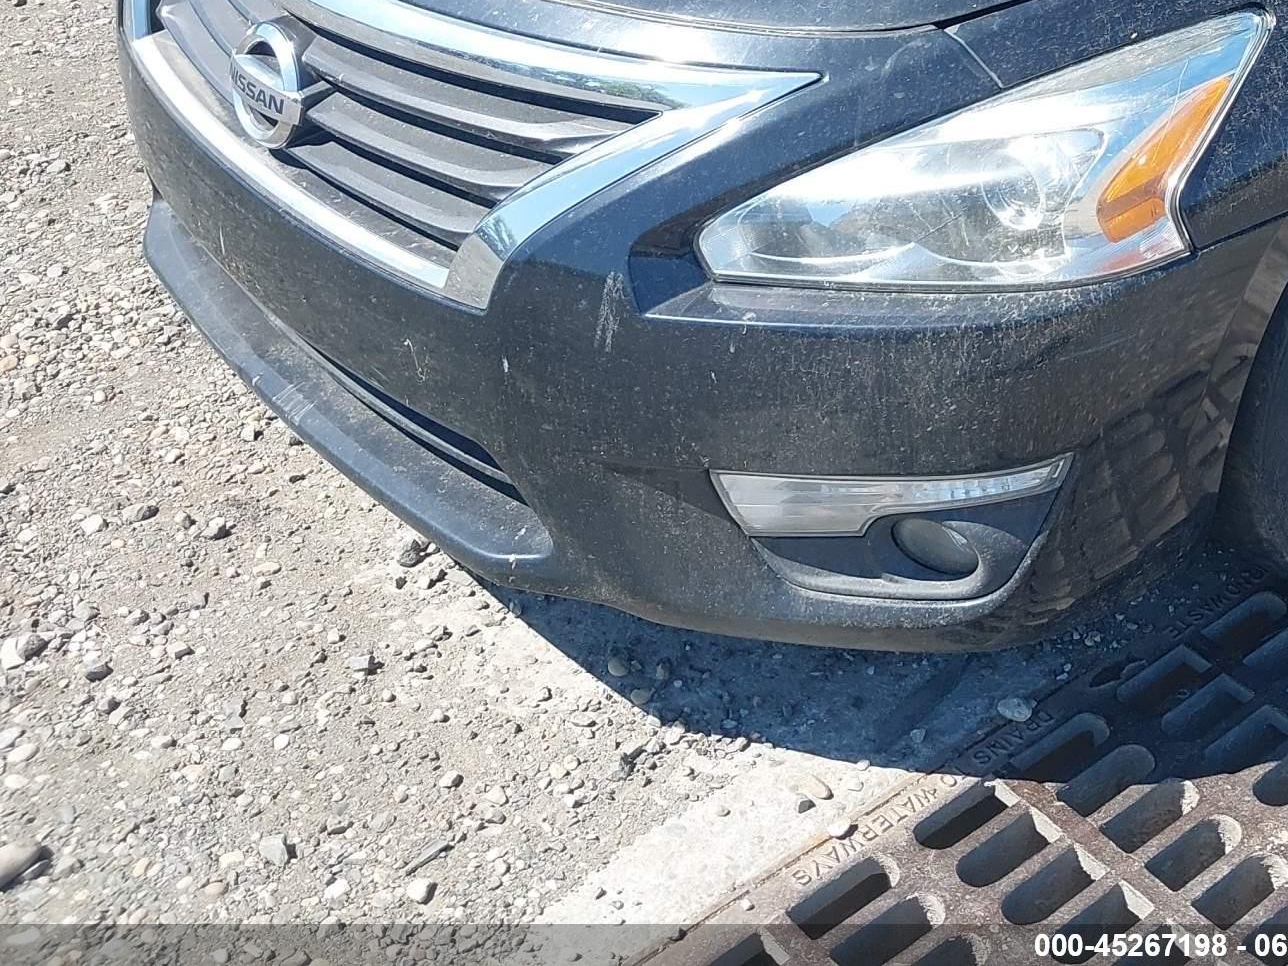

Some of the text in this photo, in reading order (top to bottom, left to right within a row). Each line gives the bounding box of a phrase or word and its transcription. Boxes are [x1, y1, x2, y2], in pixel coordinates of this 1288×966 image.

[229, 64, 285, 115] NISSAN
[972, 711, 1056, 765] DRAINS
[792, 788, 937, 885] WATERWAYS
